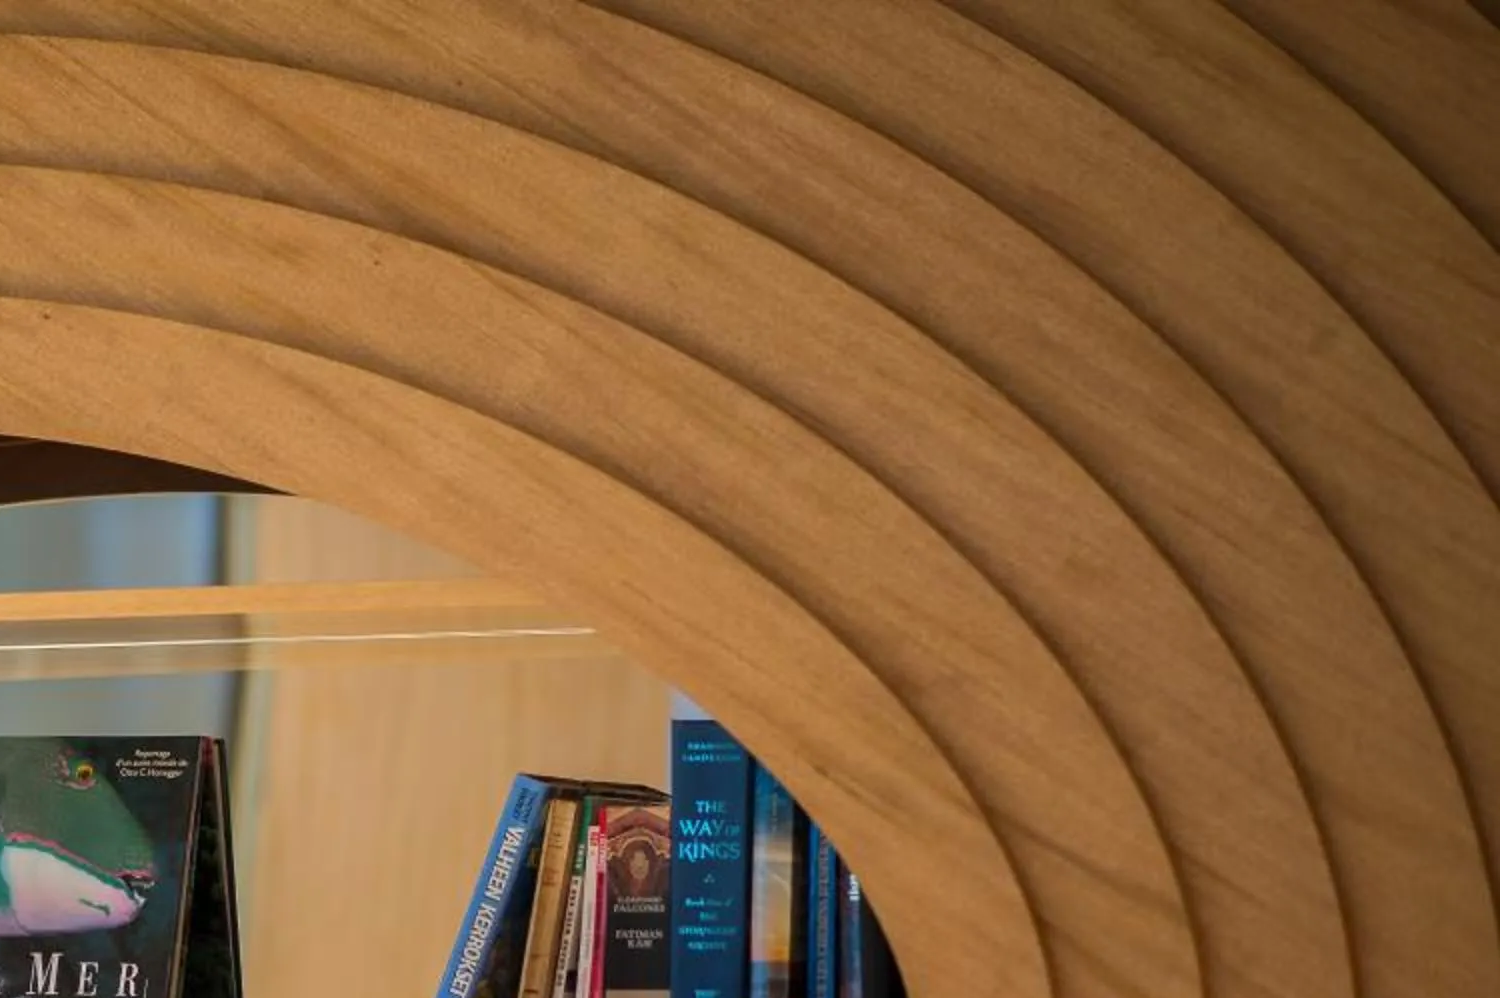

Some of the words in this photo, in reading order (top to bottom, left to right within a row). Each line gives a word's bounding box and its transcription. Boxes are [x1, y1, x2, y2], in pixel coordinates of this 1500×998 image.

[695, 800, 726, 813] THE
[679, 819, 724, 836] WAY
[484, 826, 526, 900] VALHEEN
[678, 840, 741, 863] KINGS
[25, 953, 140, 997] MER
